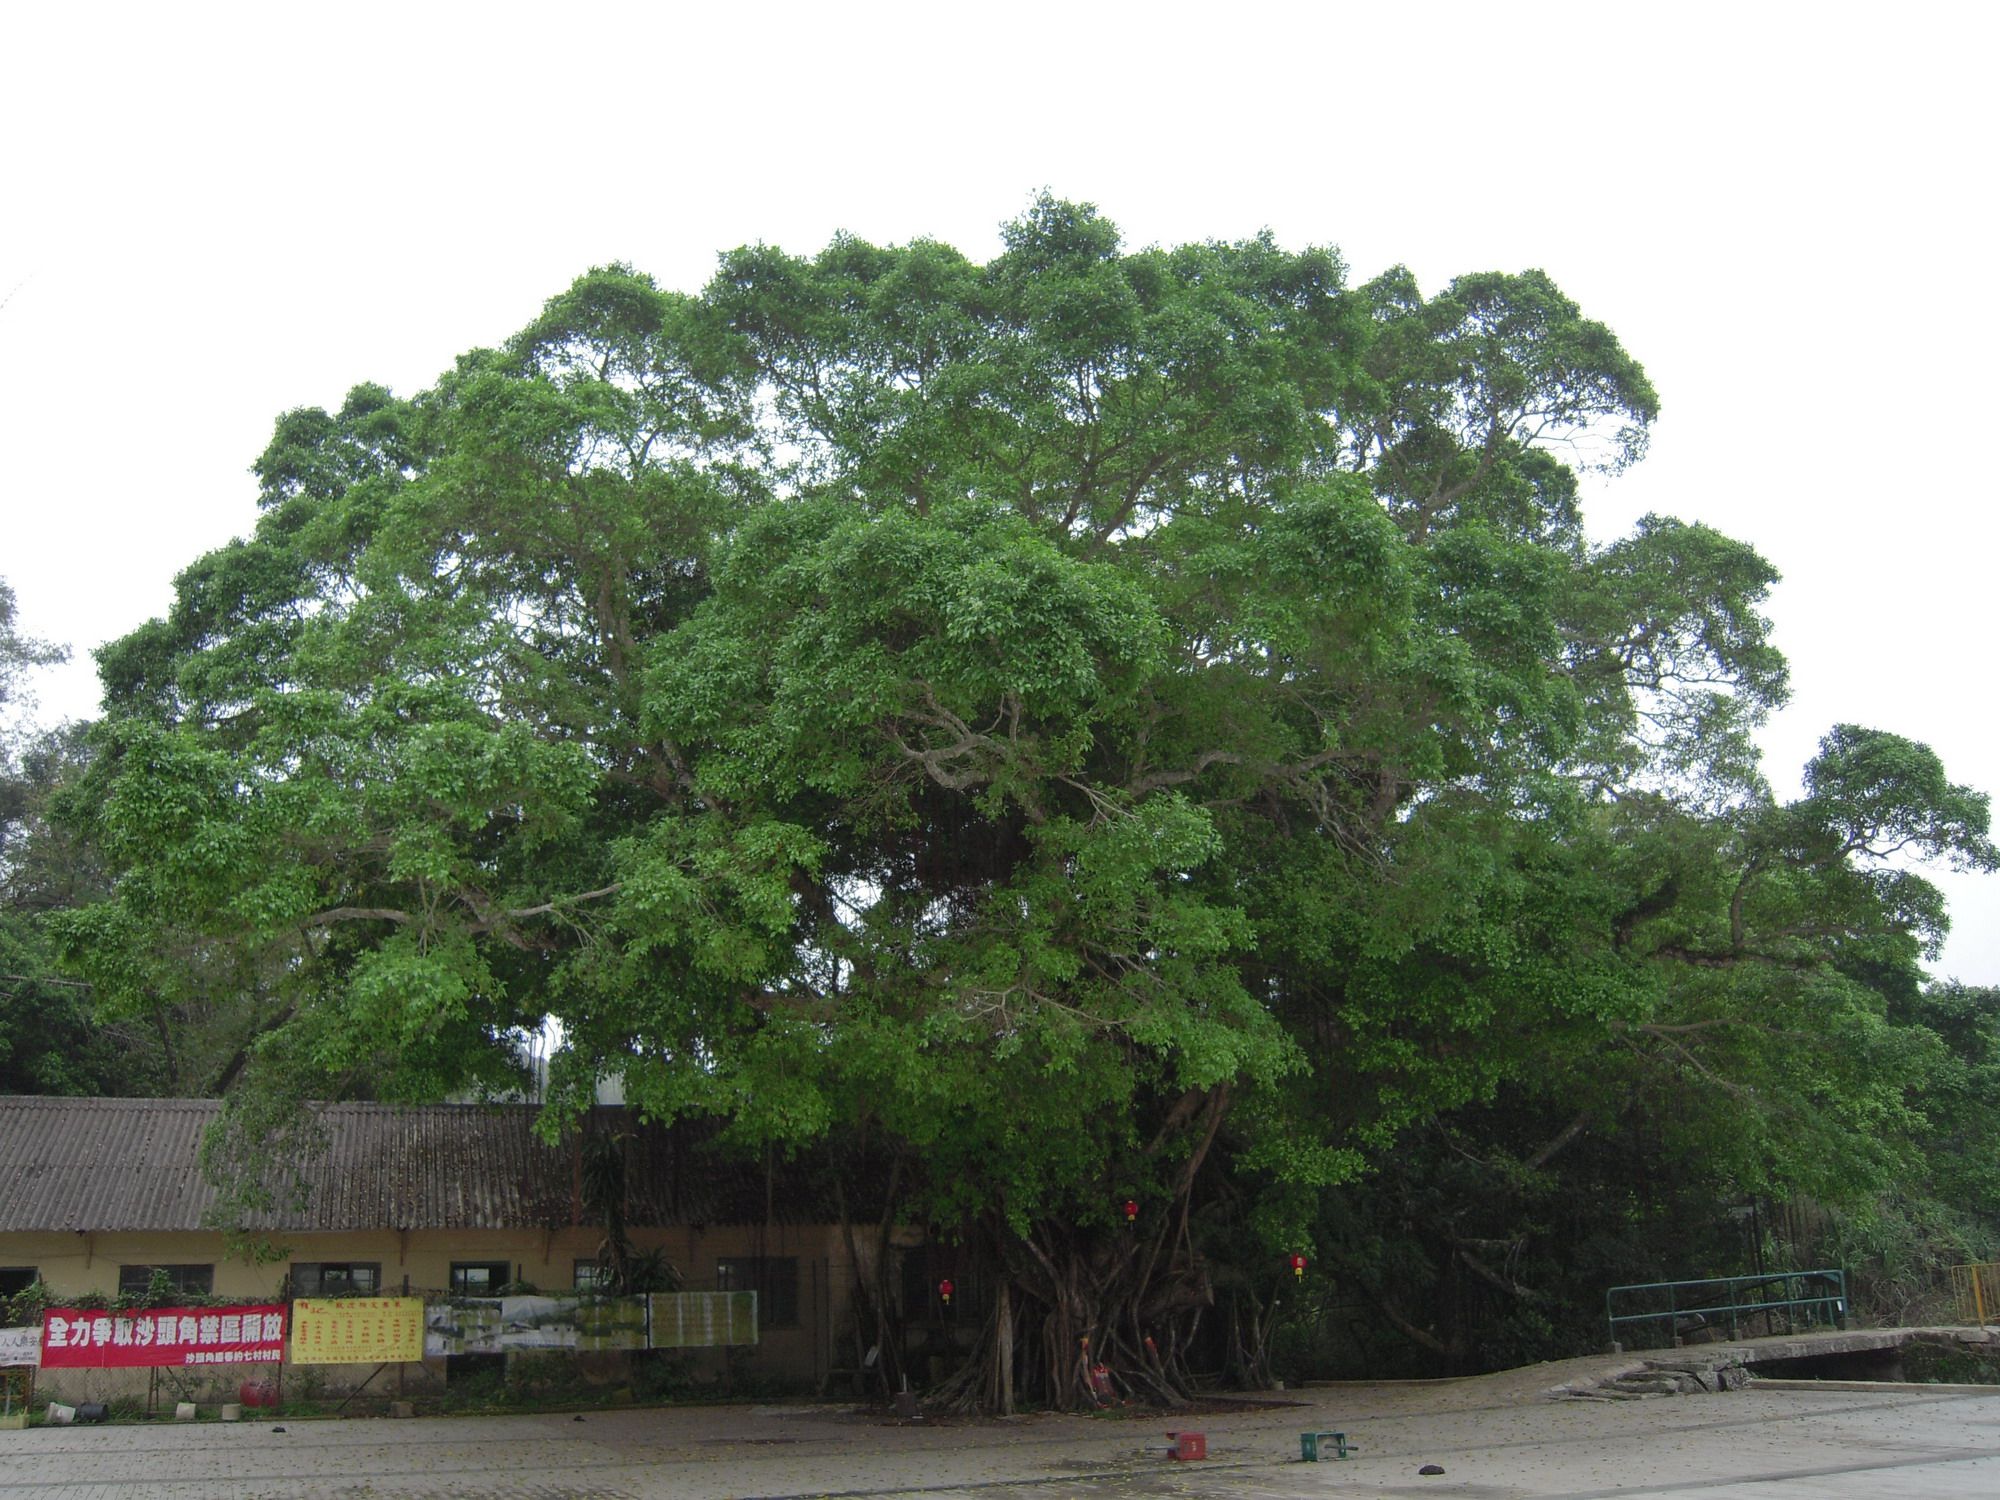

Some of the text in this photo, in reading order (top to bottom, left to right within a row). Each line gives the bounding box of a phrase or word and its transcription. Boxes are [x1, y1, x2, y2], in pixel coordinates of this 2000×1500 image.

[48, 1314, 282, 1347] 全力爭取沙頭角禁區開放
